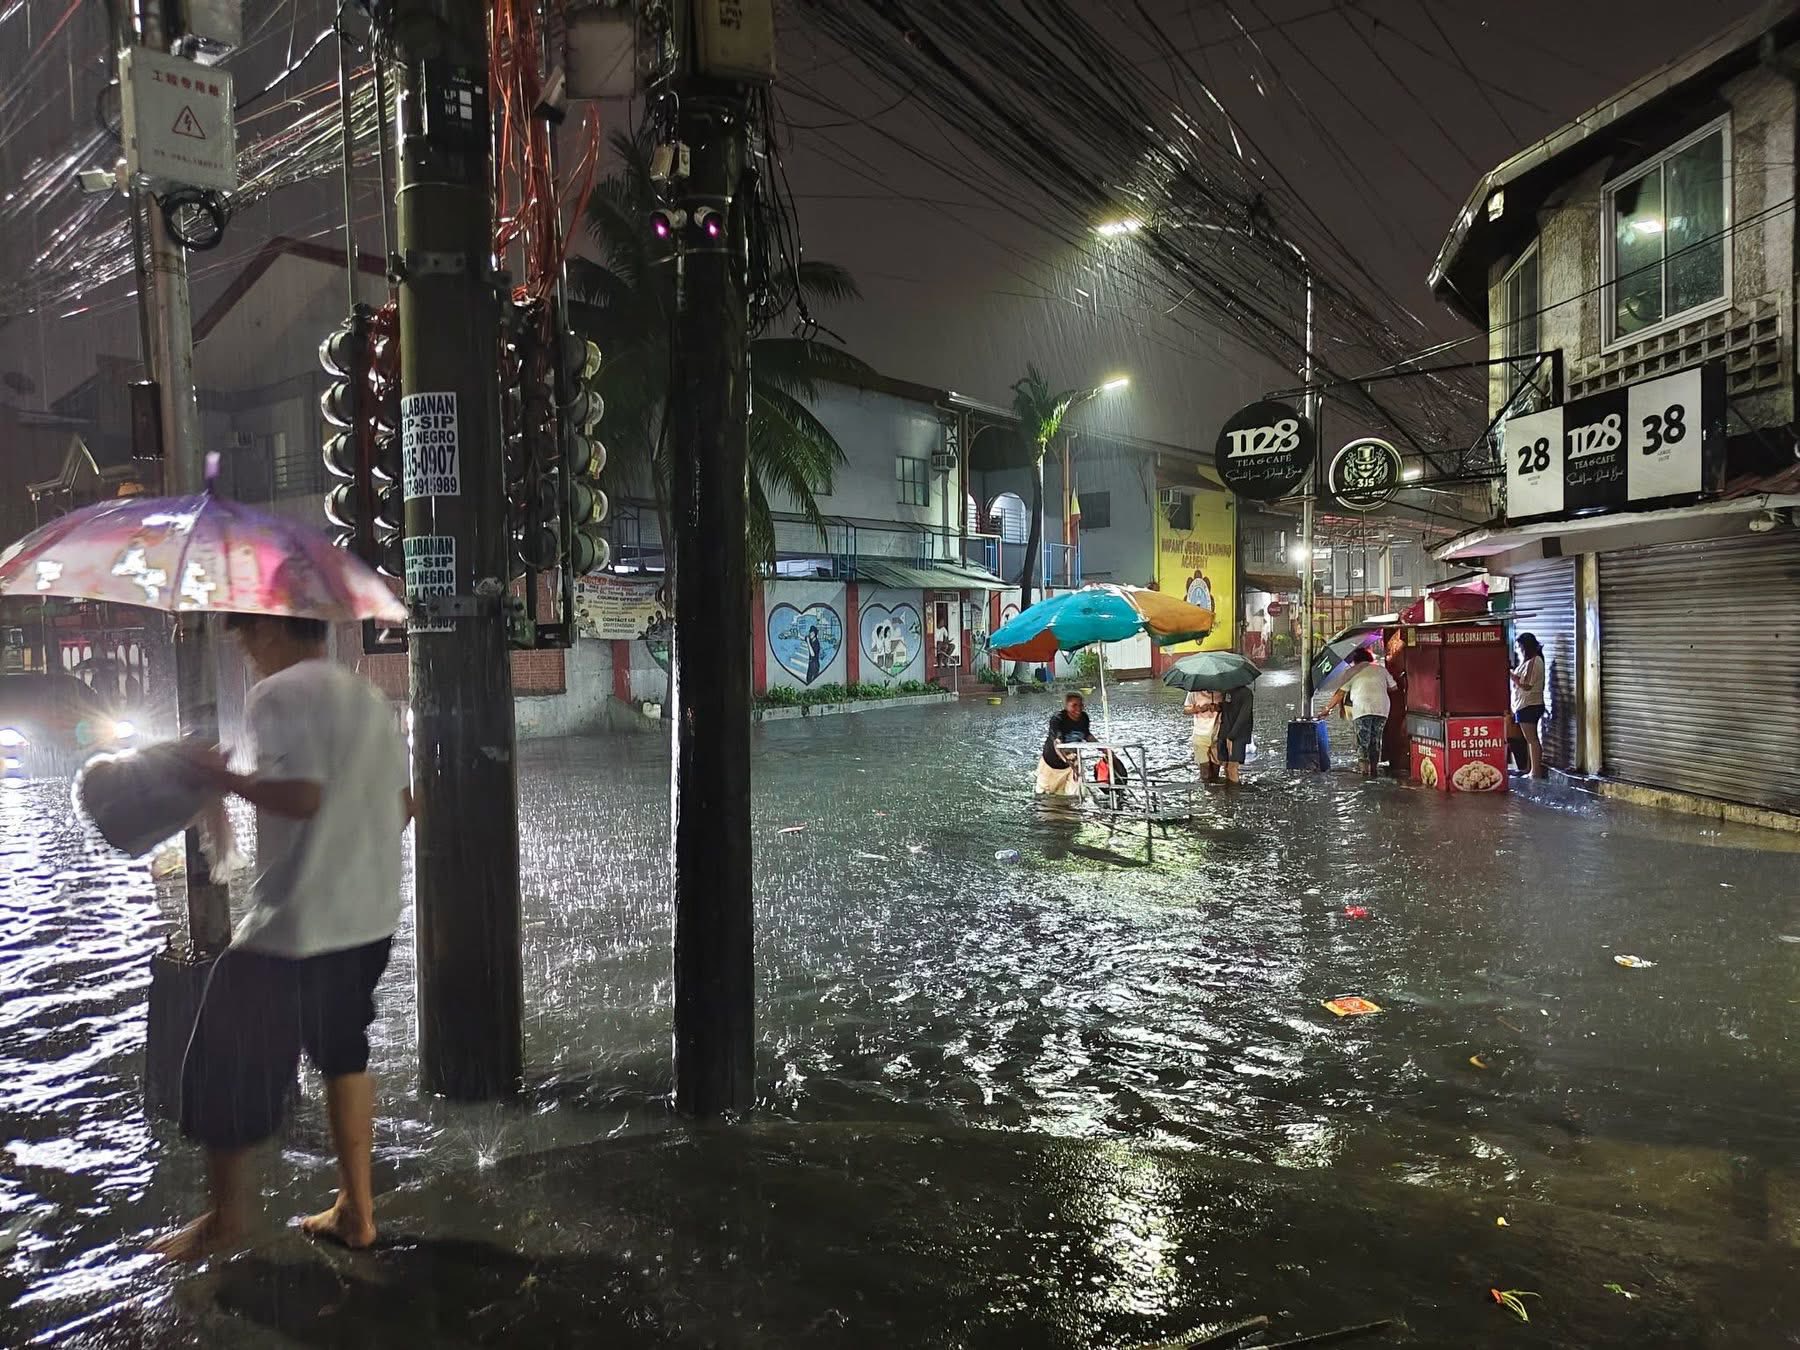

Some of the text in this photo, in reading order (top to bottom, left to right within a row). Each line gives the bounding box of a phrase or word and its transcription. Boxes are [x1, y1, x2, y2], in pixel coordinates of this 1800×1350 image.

[1642, 403, 1686, 456] 38
[416, 430, 455, 445] NEGRO
[1236, 458, 1255, 468] TEA
[1518, 437, 1550, 475] 28
[1574, 460, 1588, 469] TEA
[418, 570, 454, 585] NEGRO
[1450, 738, 1502, 749] BIG SIOMAI
